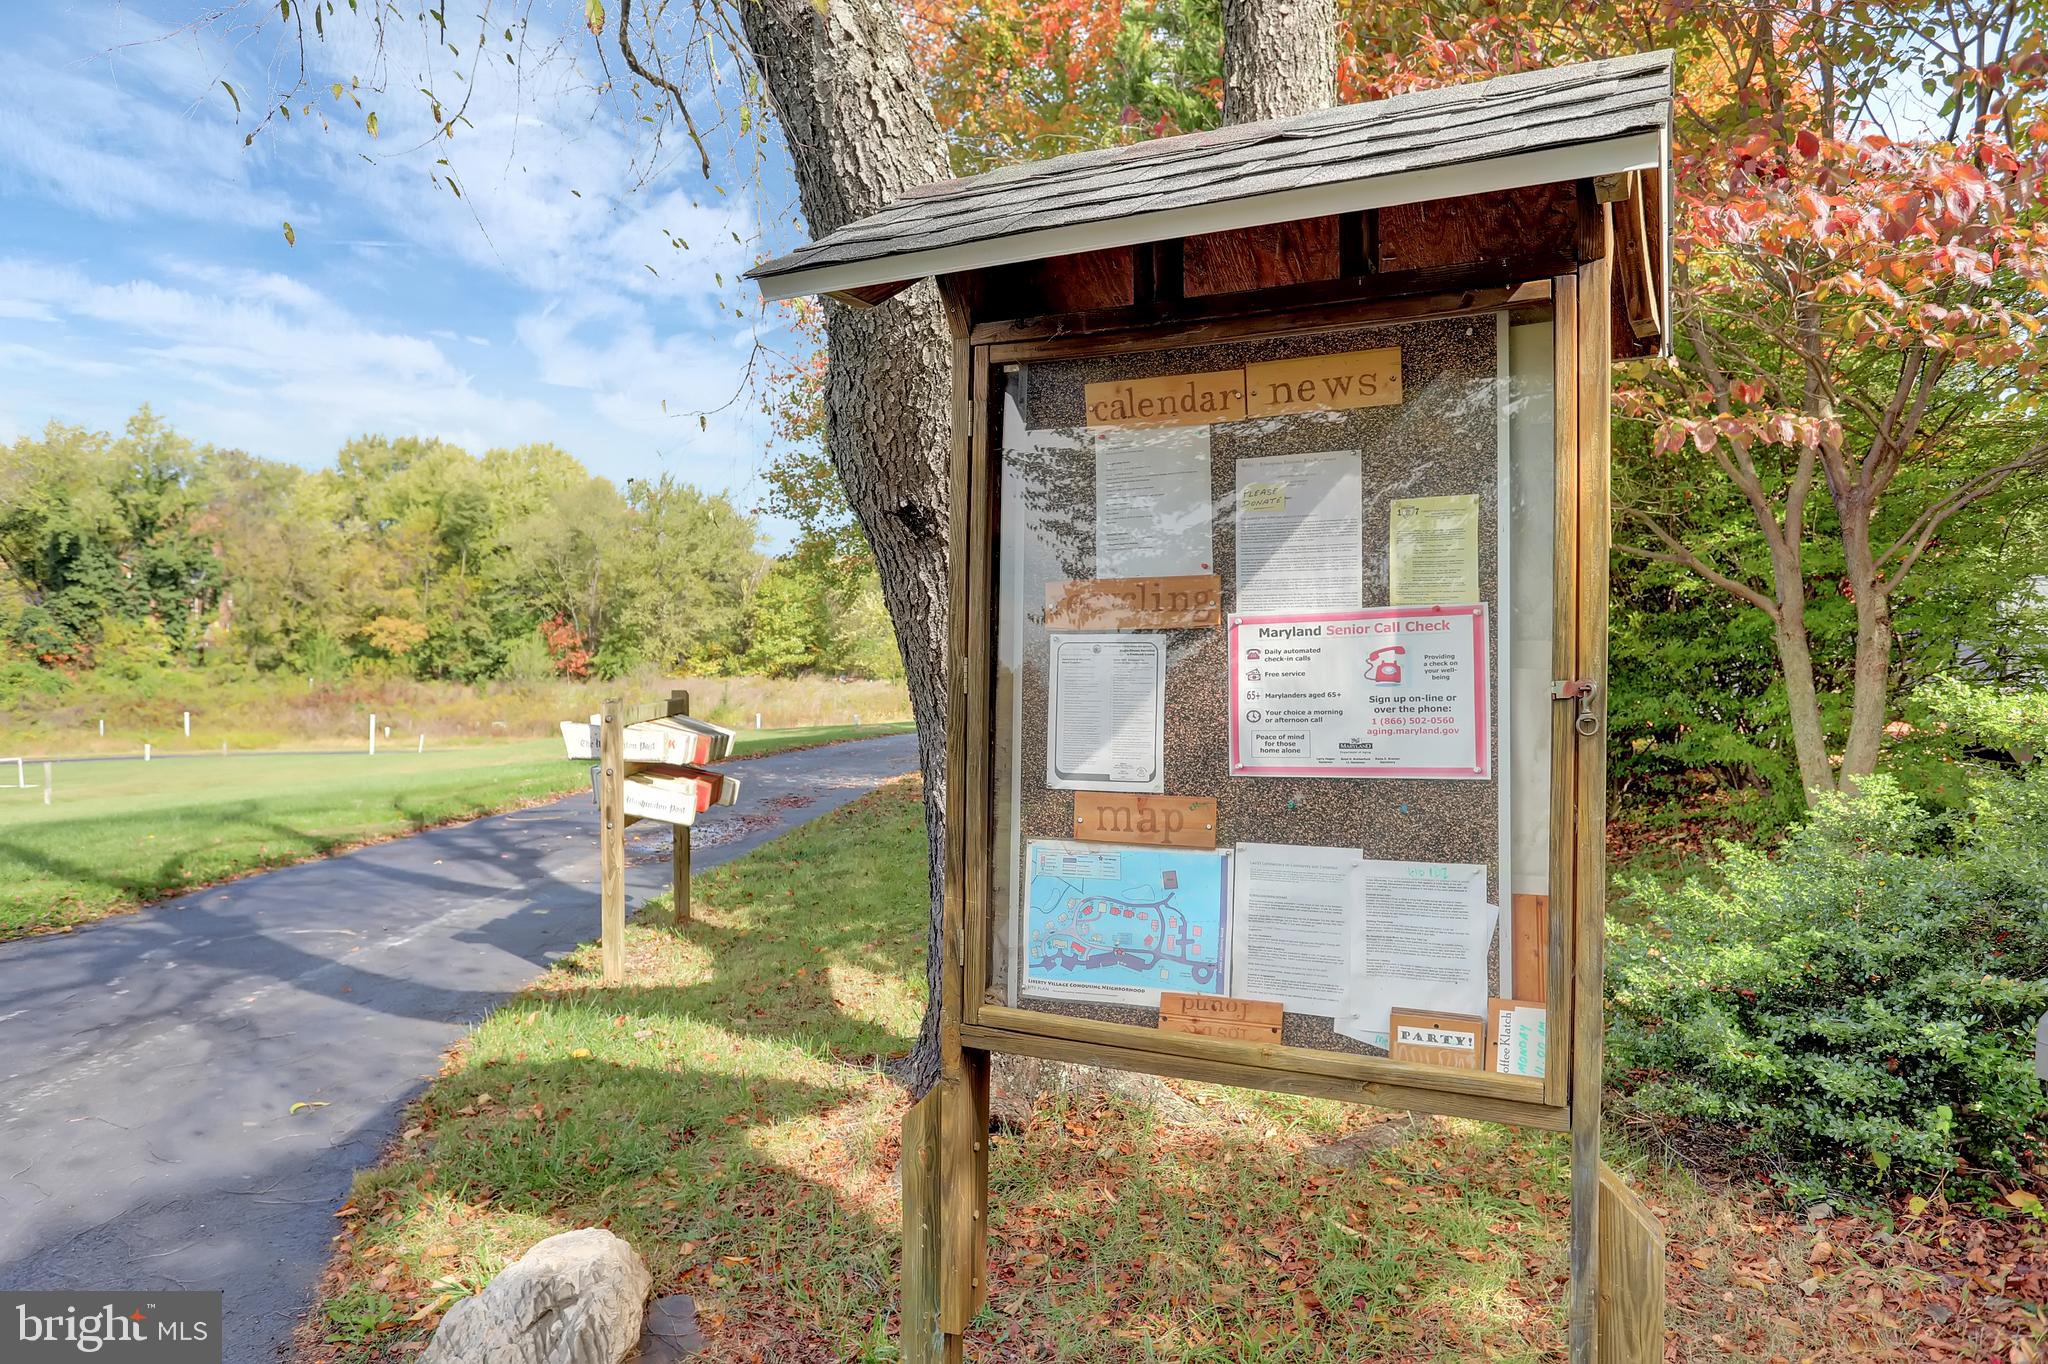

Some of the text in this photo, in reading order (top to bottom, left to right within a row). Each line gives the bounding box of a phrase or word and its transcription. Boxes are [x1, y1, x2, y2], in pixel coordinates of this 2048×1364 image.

[1269, 371, 1378, 405] news
[1093, 381, 1237, 422] calendar
[1243, 487, 1279, 498] PLEASE
[1241, 496, 1282, 507] DONATE
[1259, 620, 1450, 640] Maryland Senior Call Check
[1264, 648, 1281, 656] Daily
[1246, 690, 1261, 700] 65+
[1369, 695, 1390, 704] Sign
[1393, 696, 1406, 704] up
[1408, 694, 1443, 702] on-line
[1398, 705, 1415, 713] the
[1417, 705, 1451, 714] phone:
[1380, 717, 1406, 726] (866)
[1409, 716, 1454, 725] 502-0560
[1366, 727, 1459, 736] aging.maryland.gov
[669, 804, 686, 814] Post
[1097, 806, 1184, 844] map
[1069, 982, 1101, 990] COHOUSING
[1102, 985, 1146, 993] NEIGHBORHOOD
[1181, 998, 1249, 1021] found
[1401, 1030, 1473, 1047] PARTY!
[1499, 1012, 1511, 1074] offee Klatch
[1516, 1024, 1531, 1074] MONDAY
